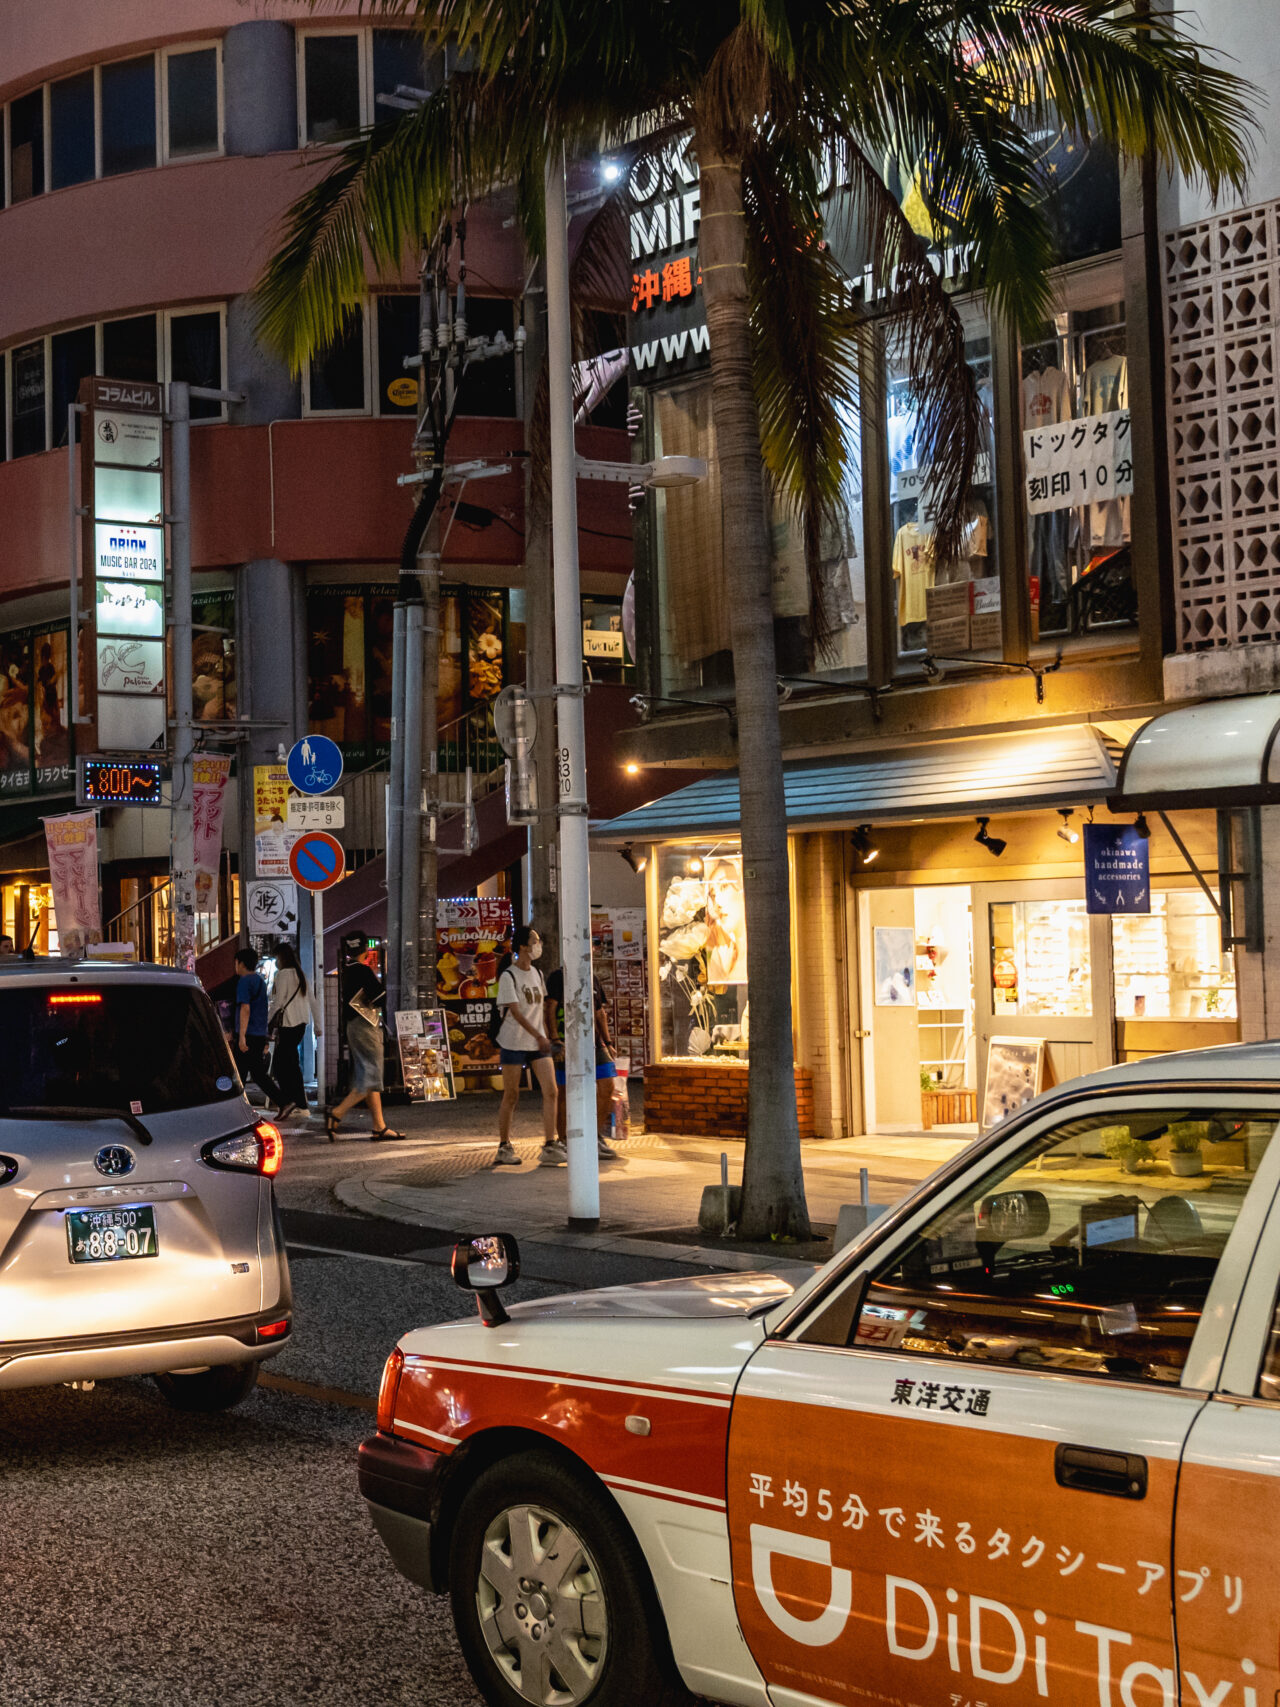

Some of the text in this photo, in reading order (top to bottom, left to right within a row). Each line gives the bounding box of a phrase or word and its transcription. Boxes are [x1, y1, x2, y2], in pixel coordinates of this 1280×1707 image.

[631, 256, 703, 312] 沖縄
[98, 386, 156, 407] コラムビル
[1030, 415, 1131, 458] ドッグタグ
[110, 537, 147, 552] ORION
[100, 554, 157, 571] MUSIC BAR 2024
[0, 769, 30, 789] タイ古式
[1100, 847, 1137, 857] okinawa
[1094, 858, 1144, 869] handmade
[1098, 871, 1142, 881] accessories
[489, 903, 501, 918] 5
[439, 928, 505, 945] Smoothie
[466, 1003, 493, 1013] POP
[75, 1227, 152, 1258] あ 88-07
[889, 1378, 993, 1417] 東洋交通
[749, 1472, 1245, 1615] 平均5分で来るタクシーアプリ
[886, 1574, 1049, 1697] DiDi
